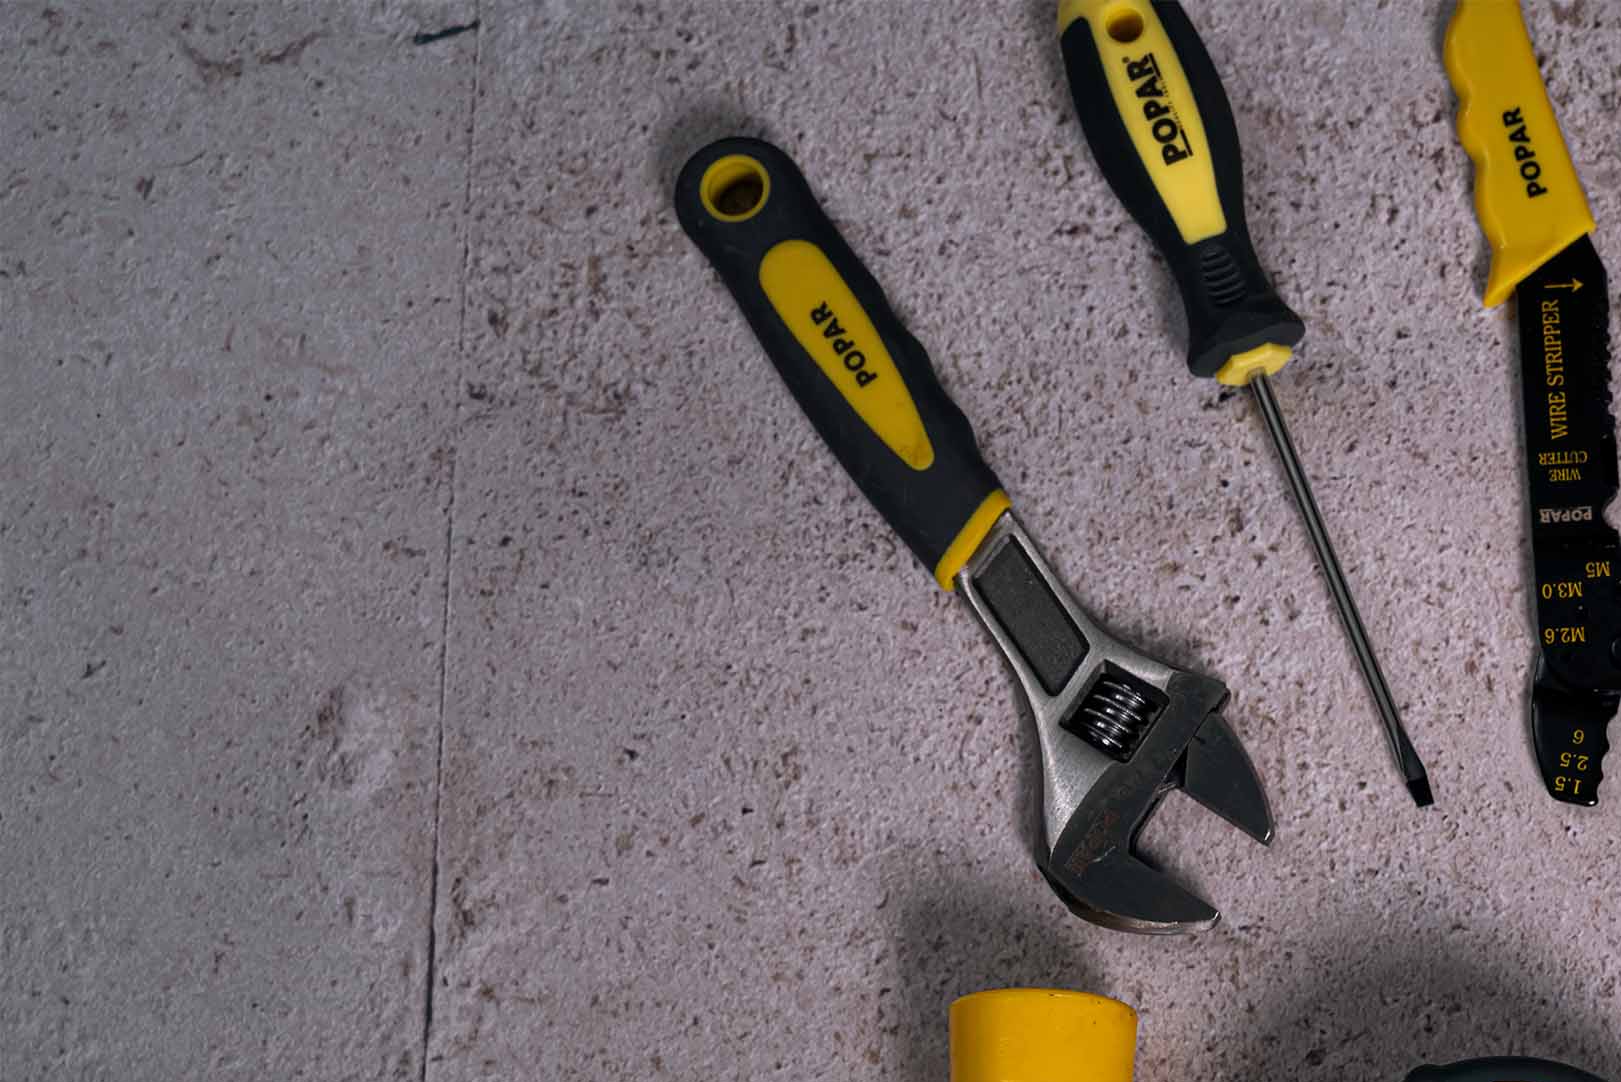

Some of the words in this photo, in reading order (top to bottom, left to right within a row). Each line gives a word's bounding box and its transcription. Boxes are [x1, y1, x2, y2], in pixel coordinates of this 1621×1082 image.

[1502, 107, 1548, 199] POPAR
[808, 299, 878, 389] POPAR
[1541, 298, 1565, 385] STRIPPER
[1549, 385, 1569, 440] WIRE
[1539, 452, 1587, 465] CUTTER
[1549, 468, 1581, 481] WIRE
[1540, 506, 1592, 523] POPAR
[1586, 562, 1610, 577] M5
[1542, 582, 1583, 599] M3.0
[1545, 627, 1585, 644] M2.6
[1573, 730, 1584, 744] 6
[1560, 752, 1587, 770] 2.5
[1555, 776, 1580, 794] 1.5
